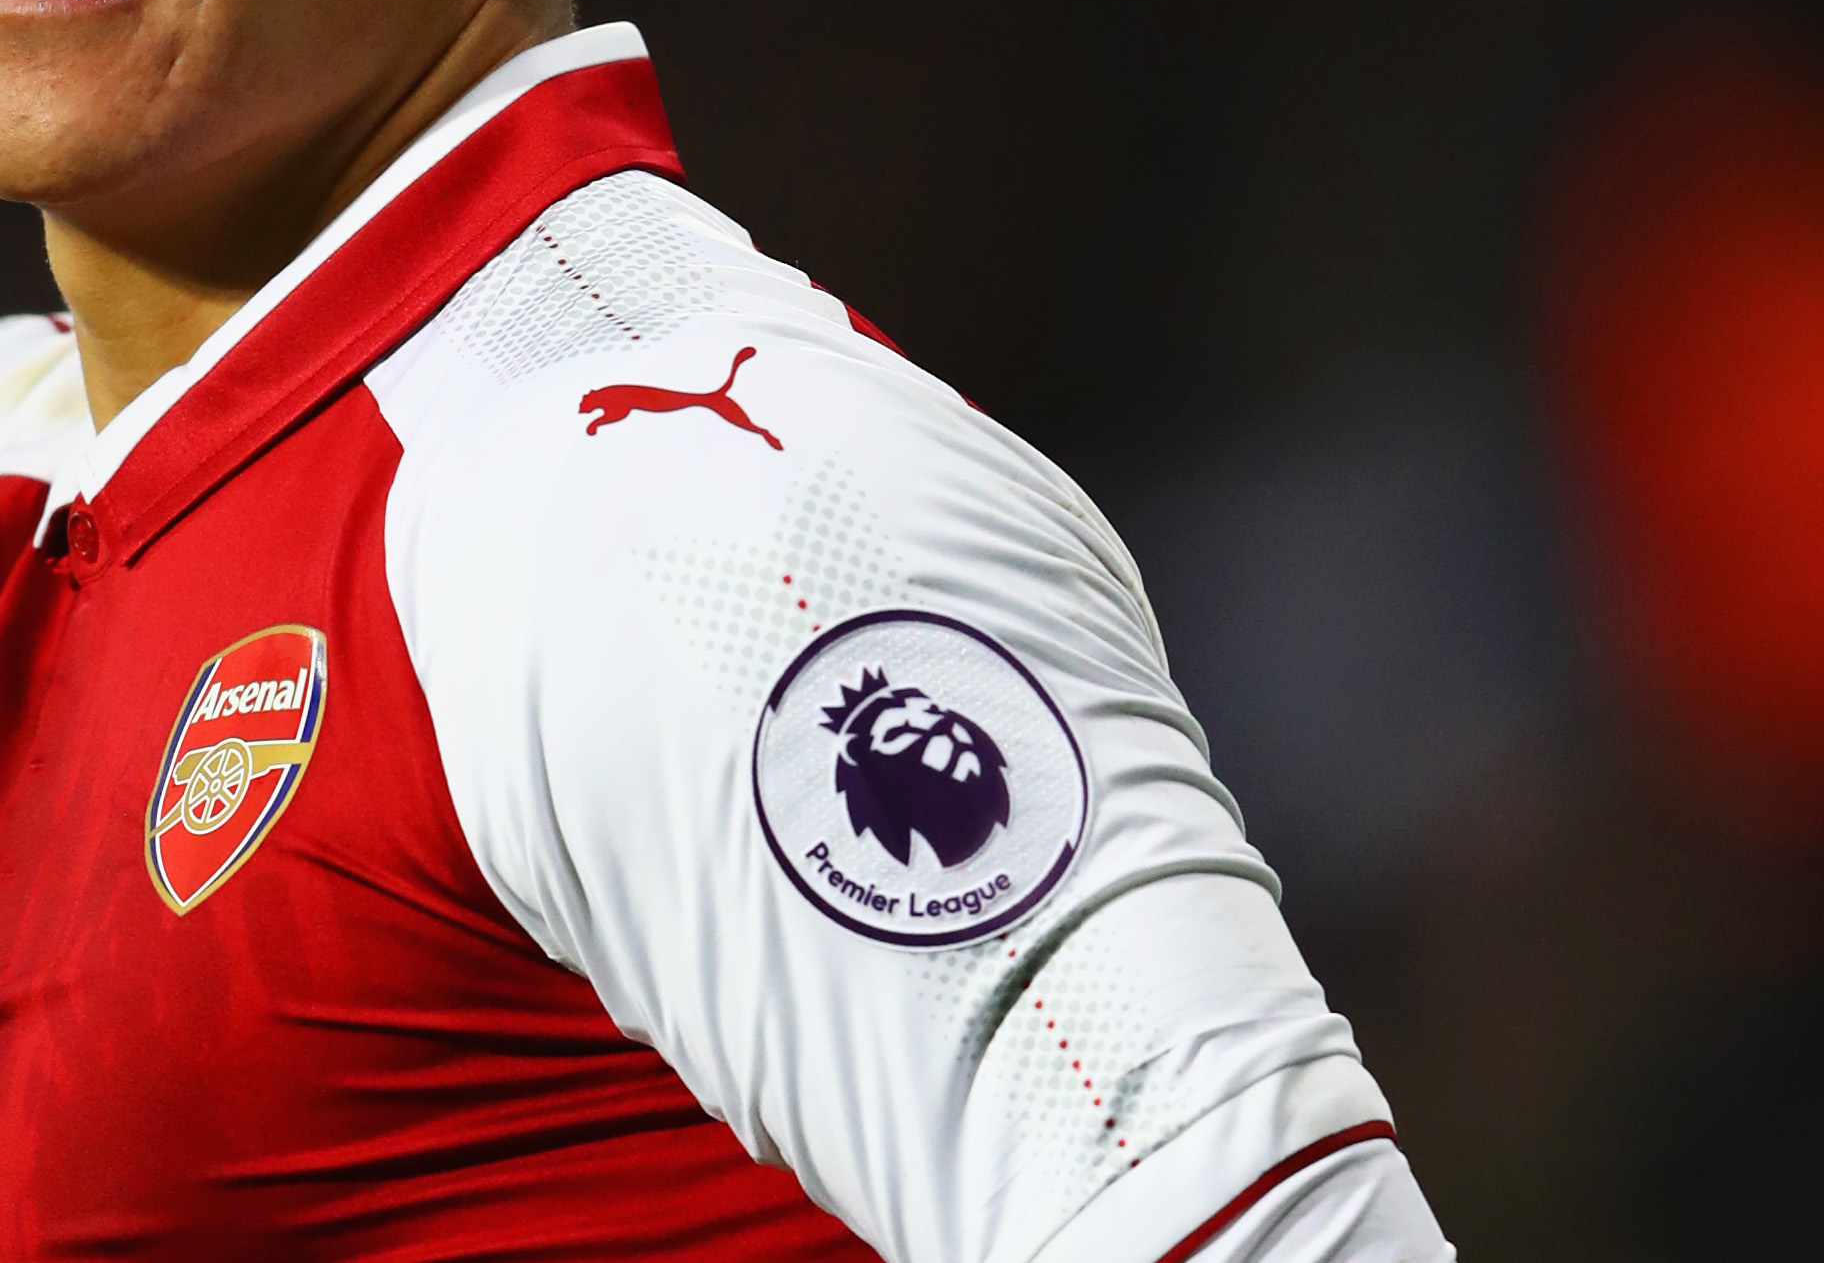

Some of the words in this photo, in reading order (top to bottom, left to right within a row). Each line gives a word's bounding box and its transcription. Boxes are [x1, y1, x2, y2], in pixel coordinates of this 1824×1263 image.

[190, 666, 308, 725] Arsenal
[805, 841, 900, 915] Premier
[909, 873, 1012, 917] League
